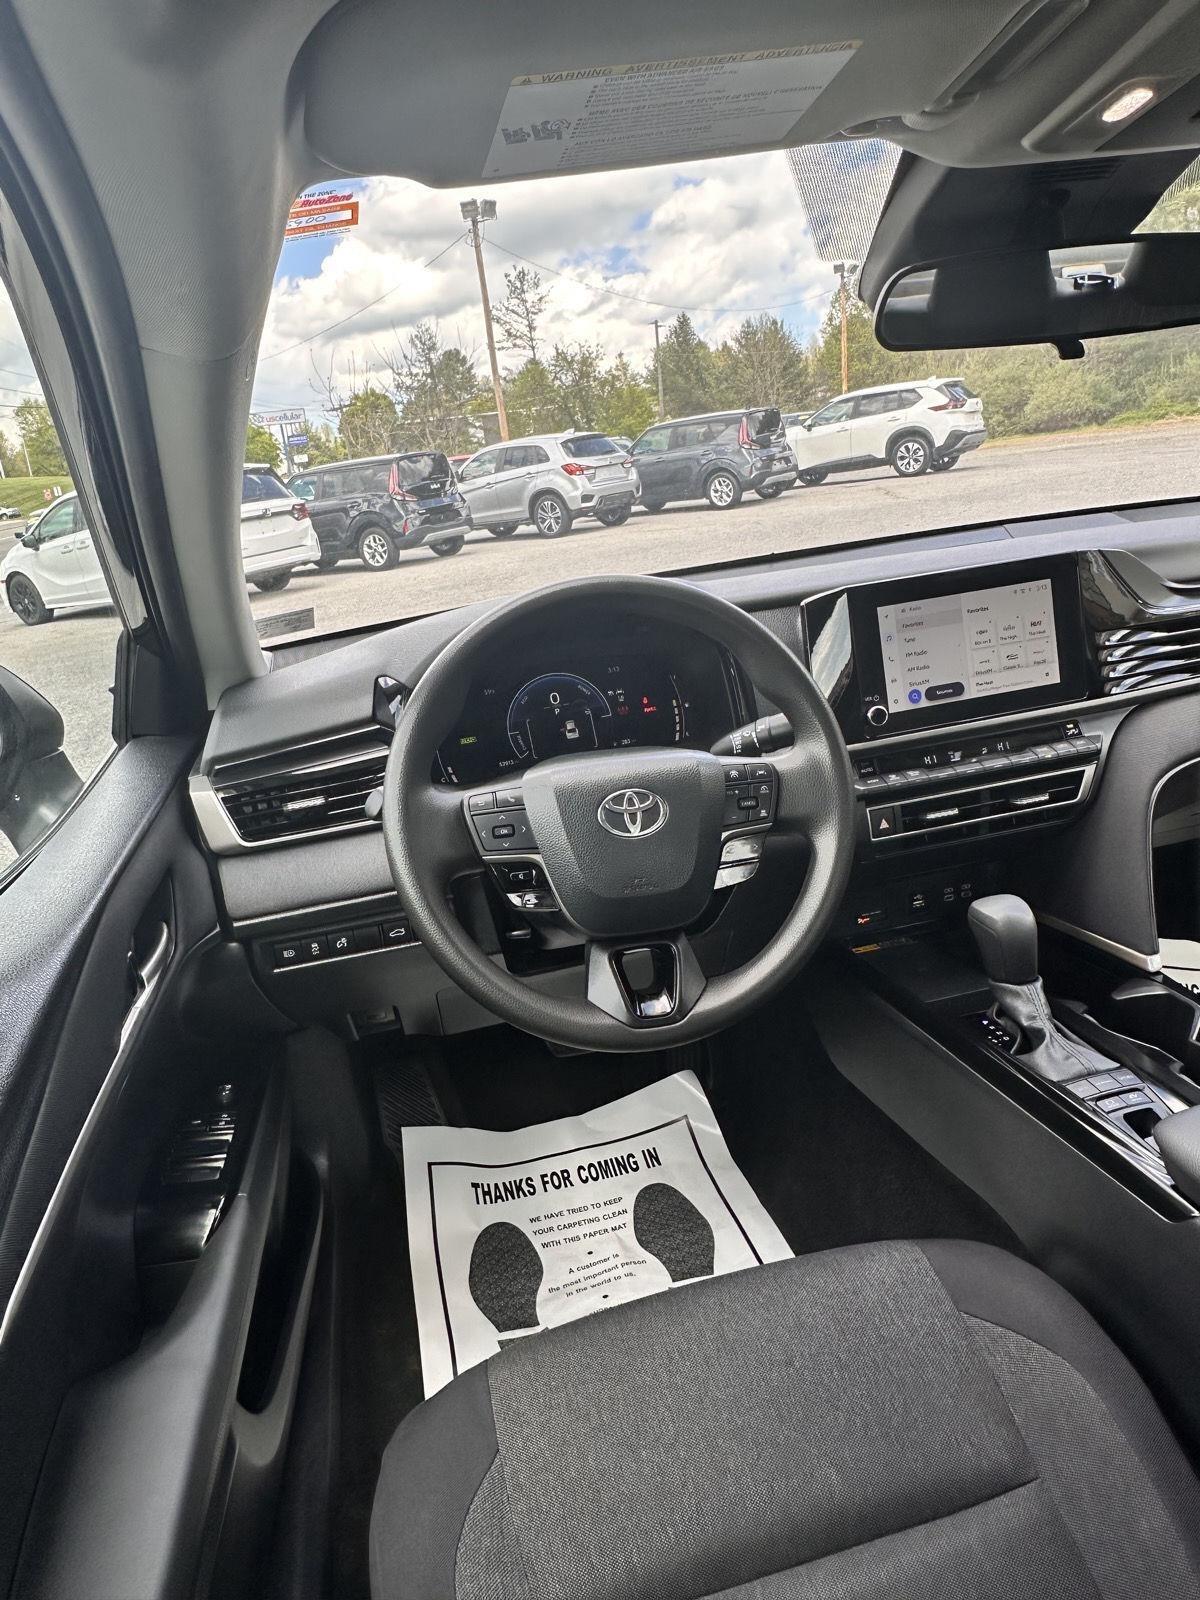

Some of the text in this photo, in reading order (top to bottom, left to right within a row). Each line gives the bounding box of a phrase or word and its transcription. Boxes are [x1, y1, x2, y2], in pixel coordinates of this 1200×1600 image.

[542, 67, 613, 83] WARNING
[301, 192, 354, 207] AutoZone
[549, 692, 560, 705] 0
[471, 1147, 662, 1205] THANKS FOR COMING IN
[529, 1196, 623, 1223] WE HAVE TRIED TO KEEP
[532, 1208, 628, 1236] YOUR CARPETING CLEAN
[541, 1222, 627, 1249] WITH THIS PAPER MAT
[576, 1256, 611, 1272] customer
[548, 1286, 561, 1294] the
[562, 1278, 582, 1289] most
[620, 1259, 647, 1269] person
[576, 1286, 588, 1294] the
[590, 1278, 612, 1288] world
